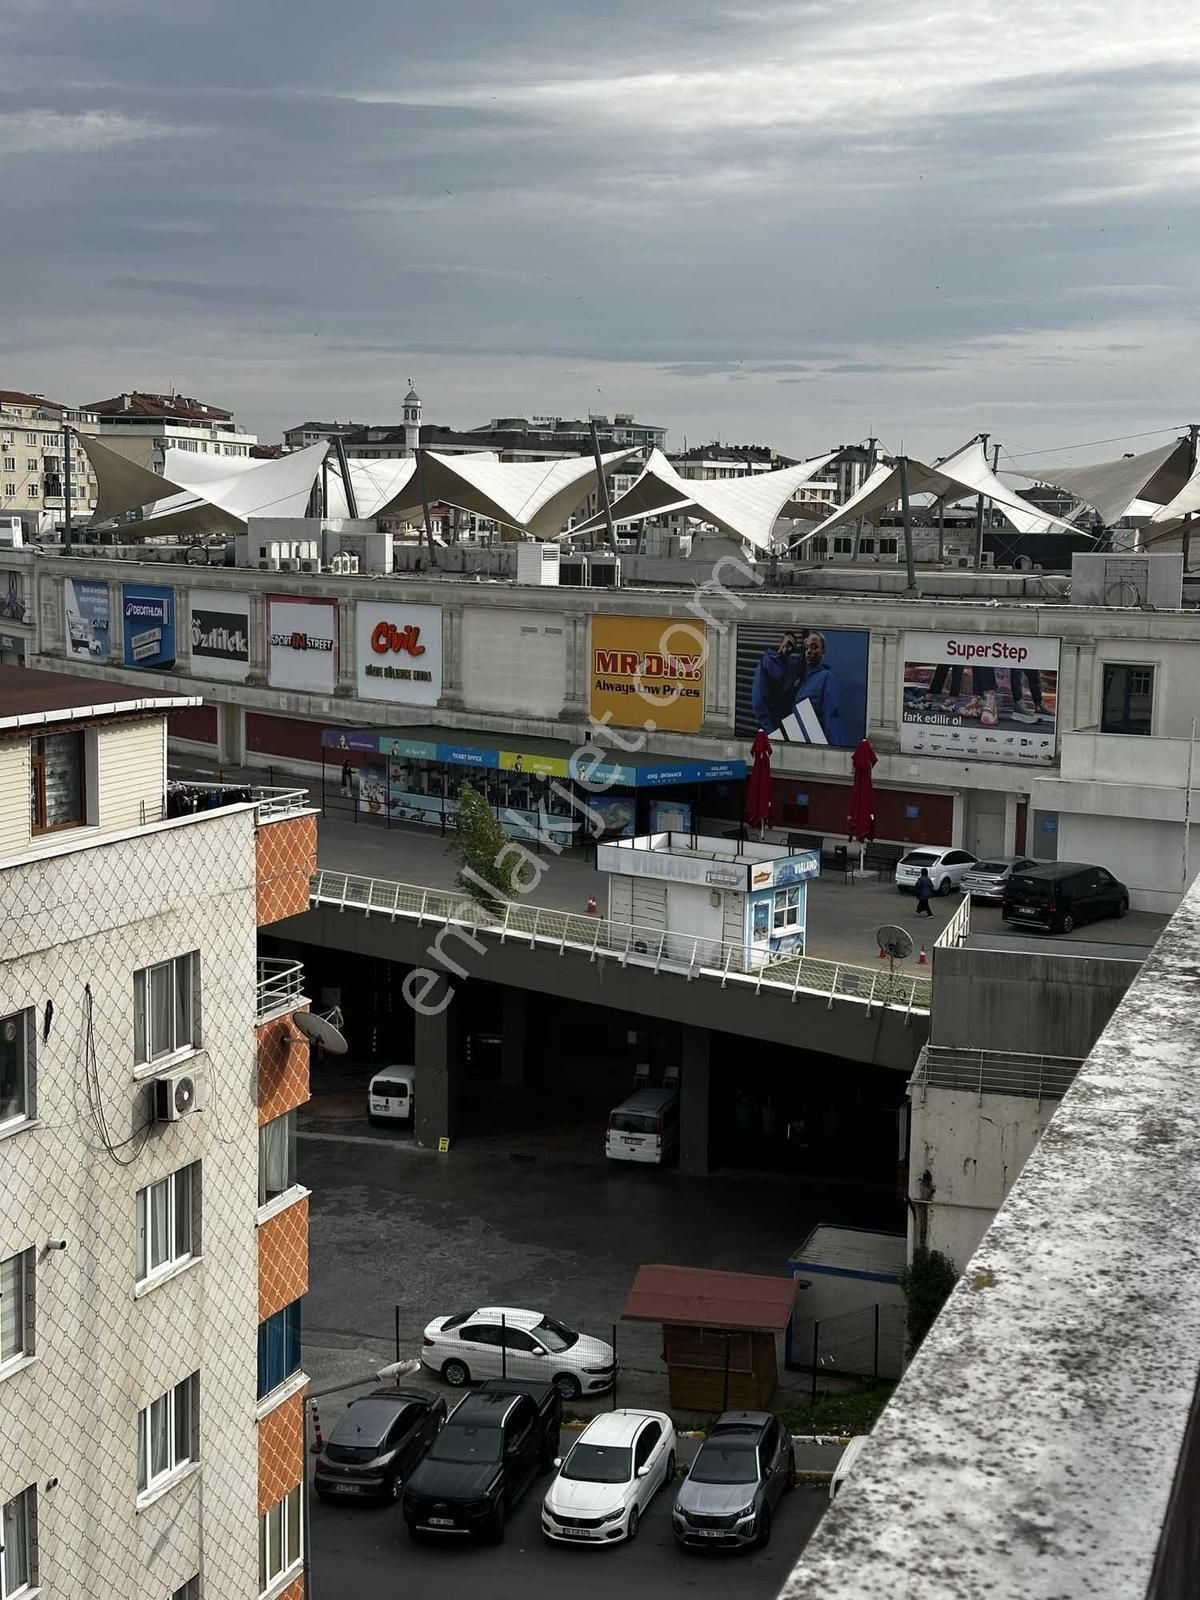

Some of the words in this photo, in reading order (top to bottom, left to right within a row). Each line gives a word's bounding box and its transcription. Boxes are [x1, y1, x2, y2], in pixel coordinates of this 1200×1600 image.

[133, 605, 163, 617] DECATHLON
[270, 634, 292, 647] SPORT
[292, 632, 307, 651] IN
[307, 637, 333, 652] STREET
[371, 621, 426, 657] Civil
[946, 640, 1028, 663] SuperStep
[595, 679, 636, 697] Always
[637, 682, 662, 695] Low
[662, 684, 701, 699] Prices
[903, 711, 923, 724] fark
[924, 713, 951, 726] edilir
[952, 715, 962, 727] ol
[794, 859, 818, 874] VIALAND
